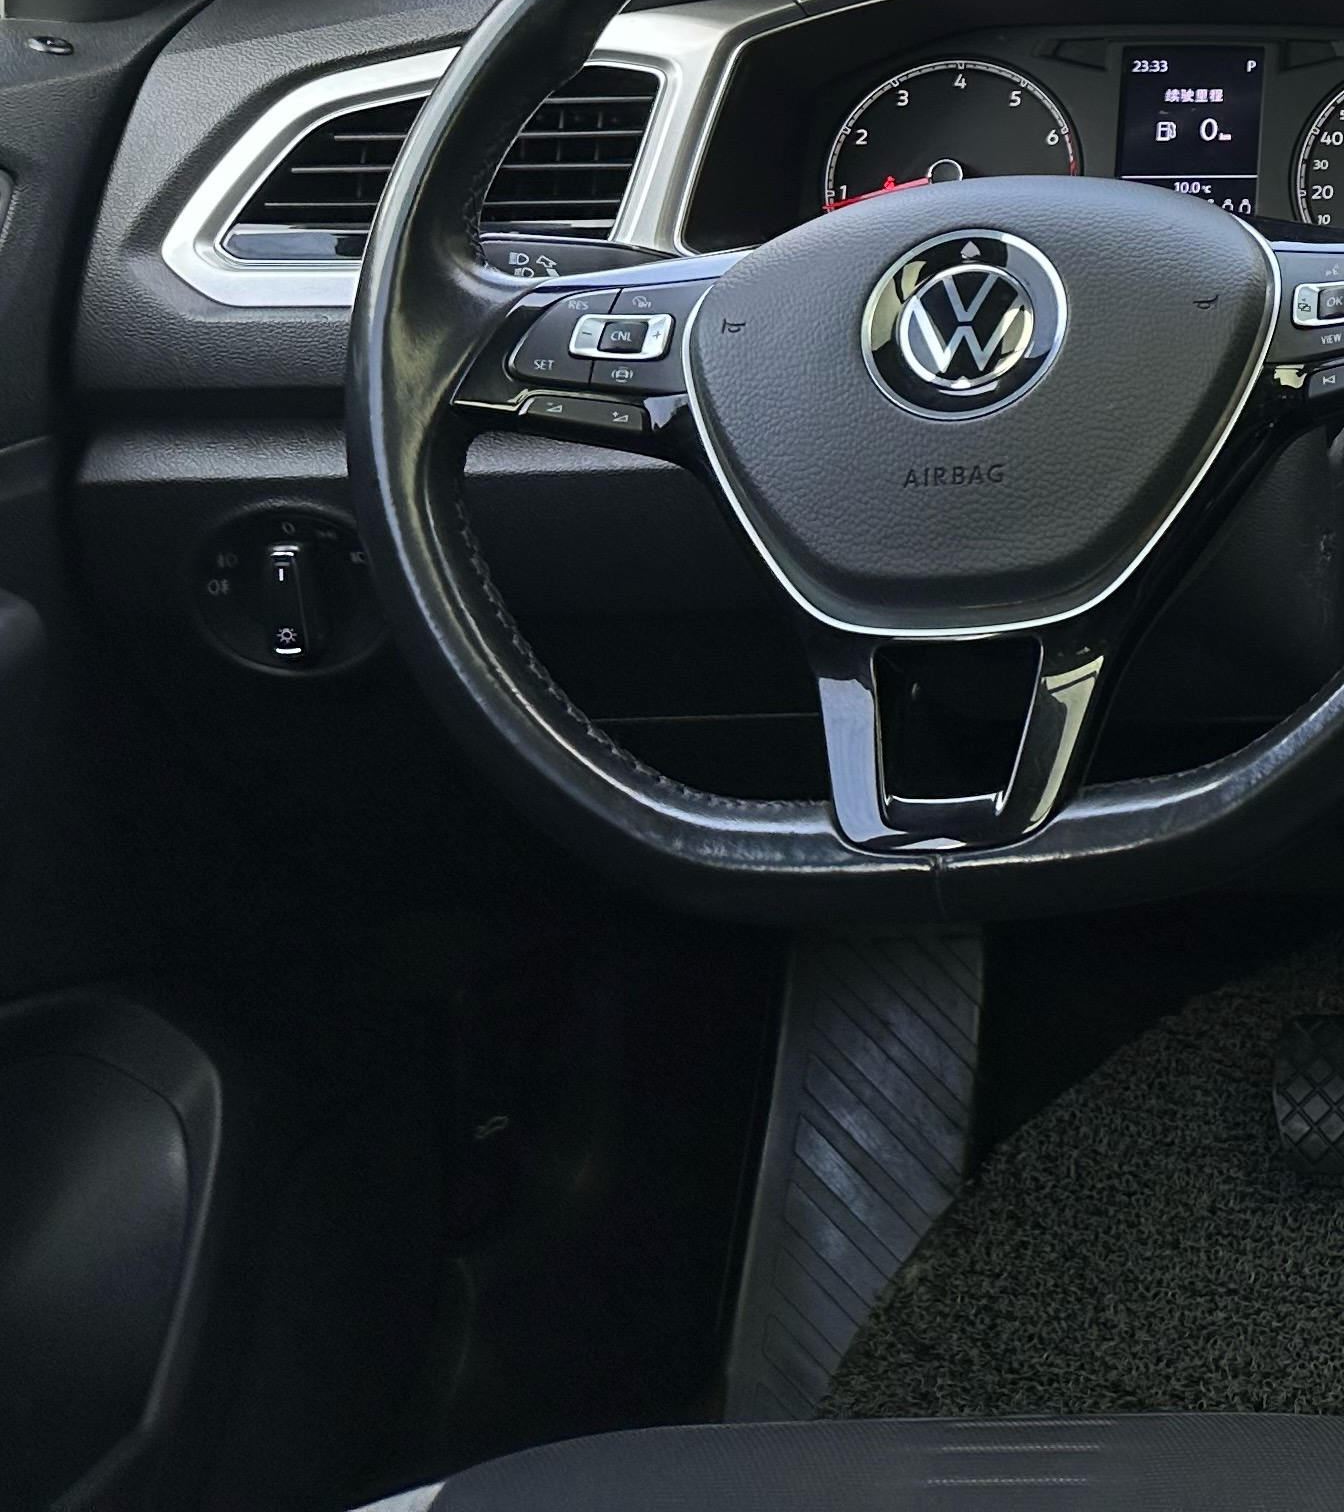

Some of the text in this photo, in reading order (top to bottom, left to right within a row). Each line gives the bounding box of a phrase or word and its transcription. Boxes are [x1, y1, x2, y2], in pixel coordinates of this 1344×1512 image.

[1132, 60, 1168, 72] 23:33
[1246, 60, 1256, 72] P
[954, 74, 966, 89] 4
[896, 91, 909, 106] 3
[1009, 91, 1021, 106] 5
[855, 129, 868, 145] 2
[1045, 130, 1059, 145] 6
[1320, 131, 1344, 145] 40
[1313, 159, 1328, 170] 30
[839, 185, 848, 199] 1
[1311, 185, 1334, 199] 20
[1317, 214, 1331, 225] 10
[568, 299, 589, 310] RES
[1326, 295, 1344, 308] OK
[610, 330, 632, 342] CNL
[1321, 332, 1342, 345] VIEW
[533, 359, 555, 370] SET
[903, 463, 1005, 488] AIRBAG
